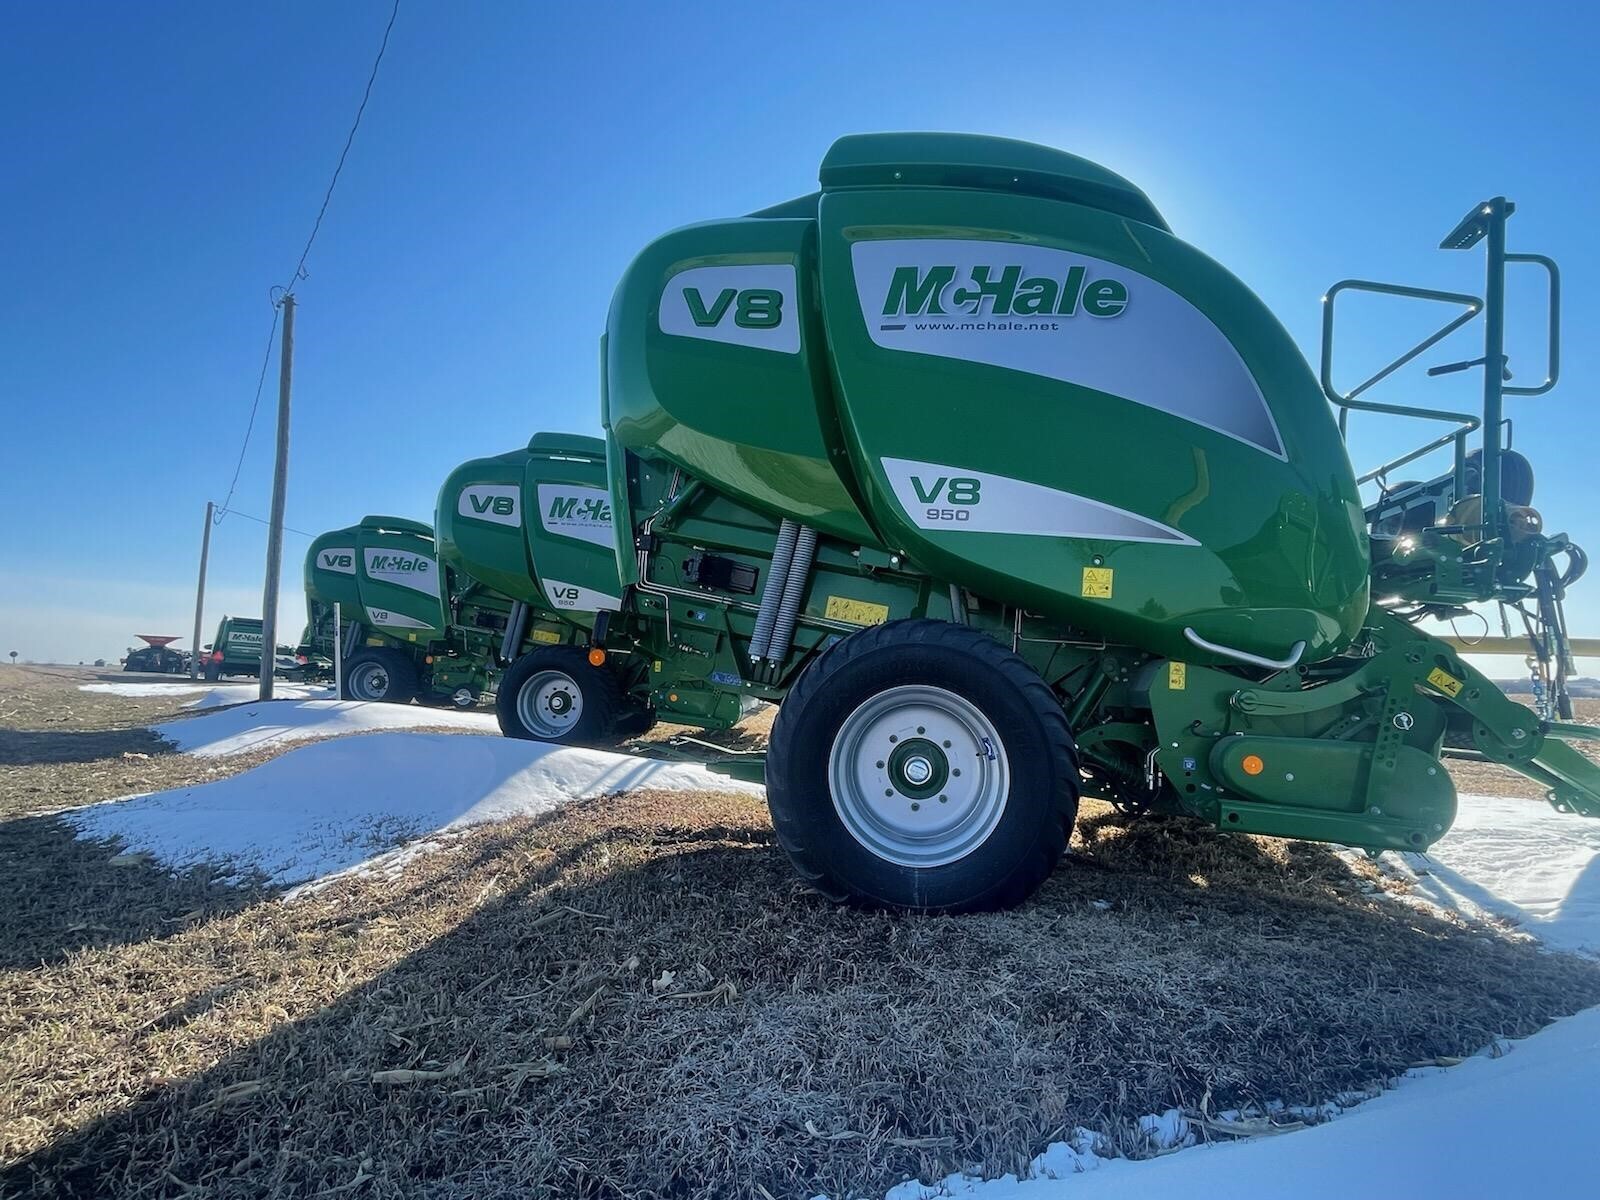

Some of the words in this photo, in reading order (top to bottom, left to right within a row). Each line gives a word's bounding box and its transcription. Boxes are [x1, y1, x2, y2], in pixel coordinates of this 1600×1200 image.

[882, 265, 1128, 318] McHale
[682, 287, 784, 330] V8
[915, 321, 1059, 332] www.mchale.net
[909, 475, 981, 506] V8
[469, 494, 515, 516] V8
[926, 508, 970, 521] 950
[323, 554, 352, 568] V8
[371, 555, 429, 572] McHale
[552, 586, 579, 600] V8
[372, 610, 389, 620] V8
